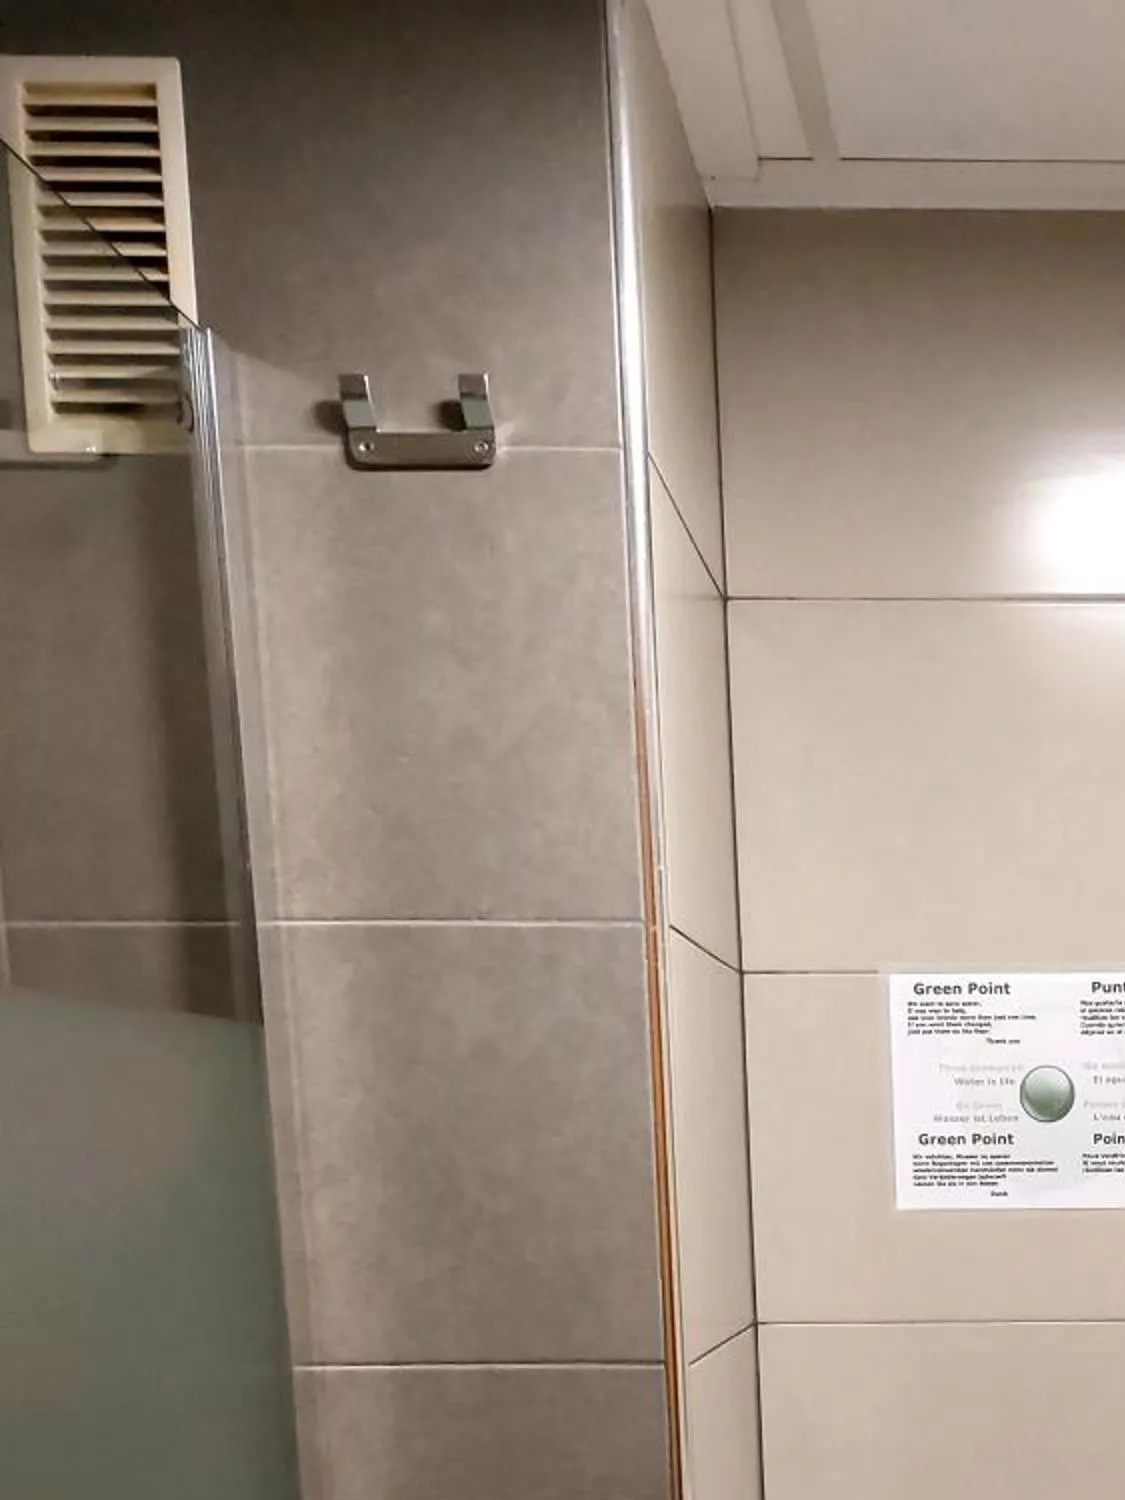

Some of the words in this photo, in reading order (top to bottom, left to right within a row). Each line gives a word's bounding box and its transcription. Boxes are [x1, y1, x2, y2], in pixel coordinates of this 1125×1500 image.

[913, 982, 963, 995] Green
[968, 981, 1011, 995] Point
[918, 1133, 967, 1146] Green
[971, 1132, 1015, 1146] Point
